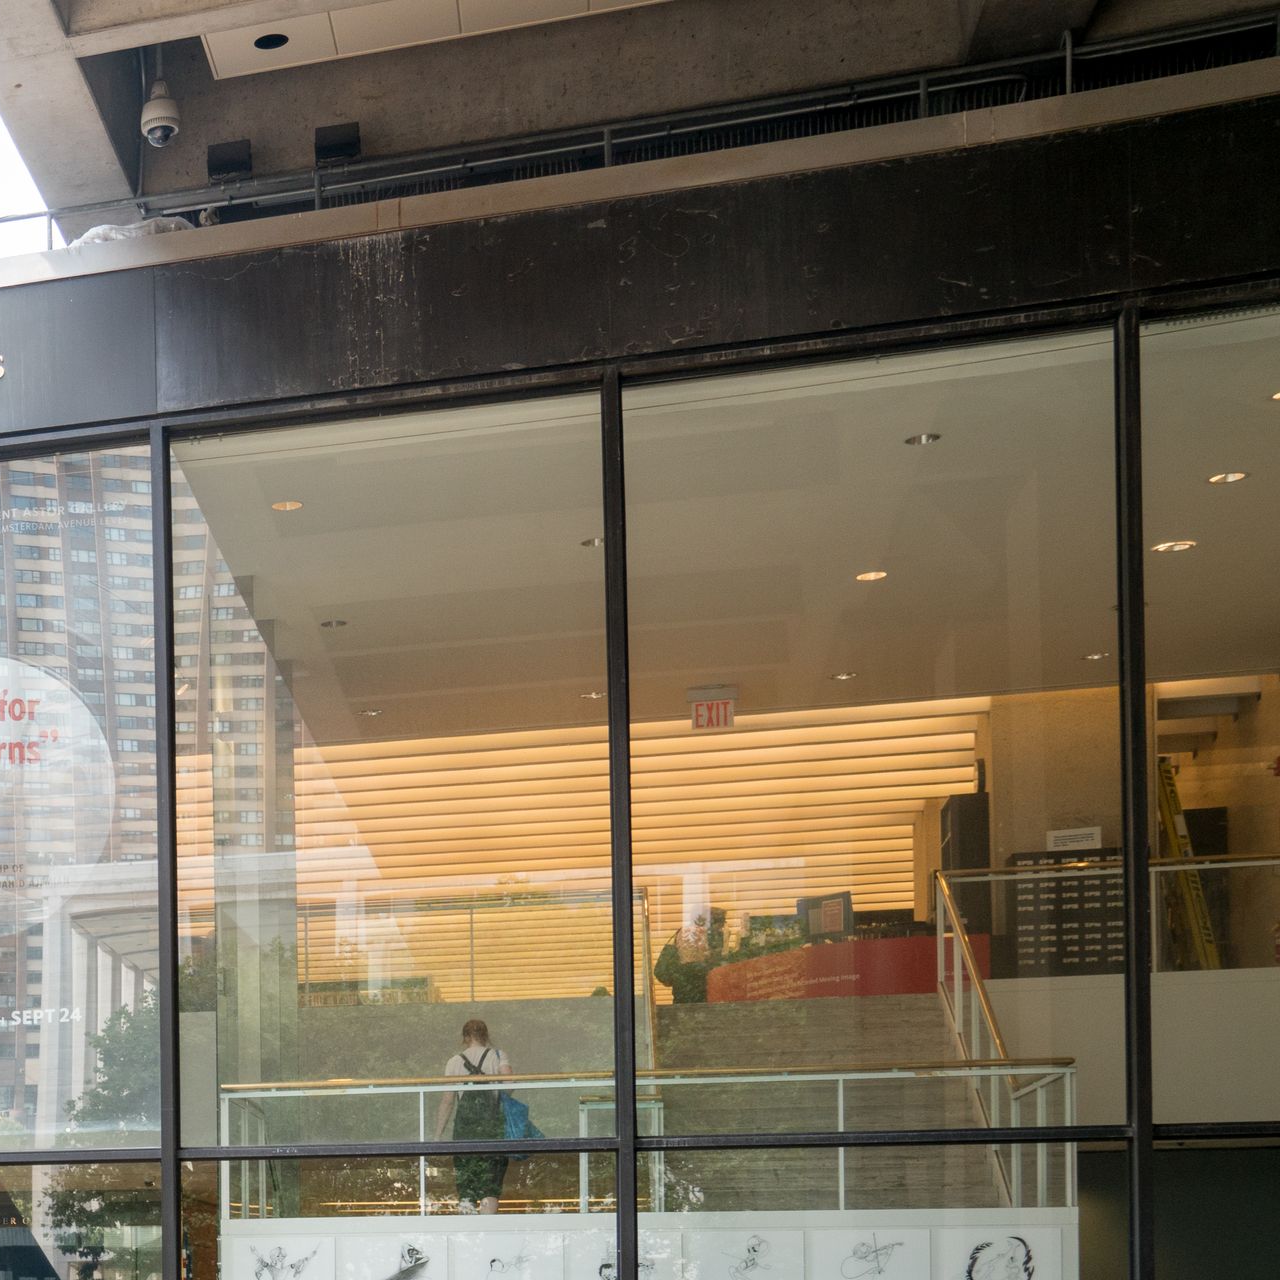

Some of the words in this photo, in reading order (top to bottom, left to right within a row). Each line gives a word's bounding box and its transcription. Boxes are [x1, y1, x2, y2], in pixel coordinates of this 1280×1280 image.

[22, 505, 65, 518] ASTOR
[694, 701, 730, 728] EXIT
[11, 1009, 55, 1026] SEPT
[59, 1007, 82, 1023] 24
